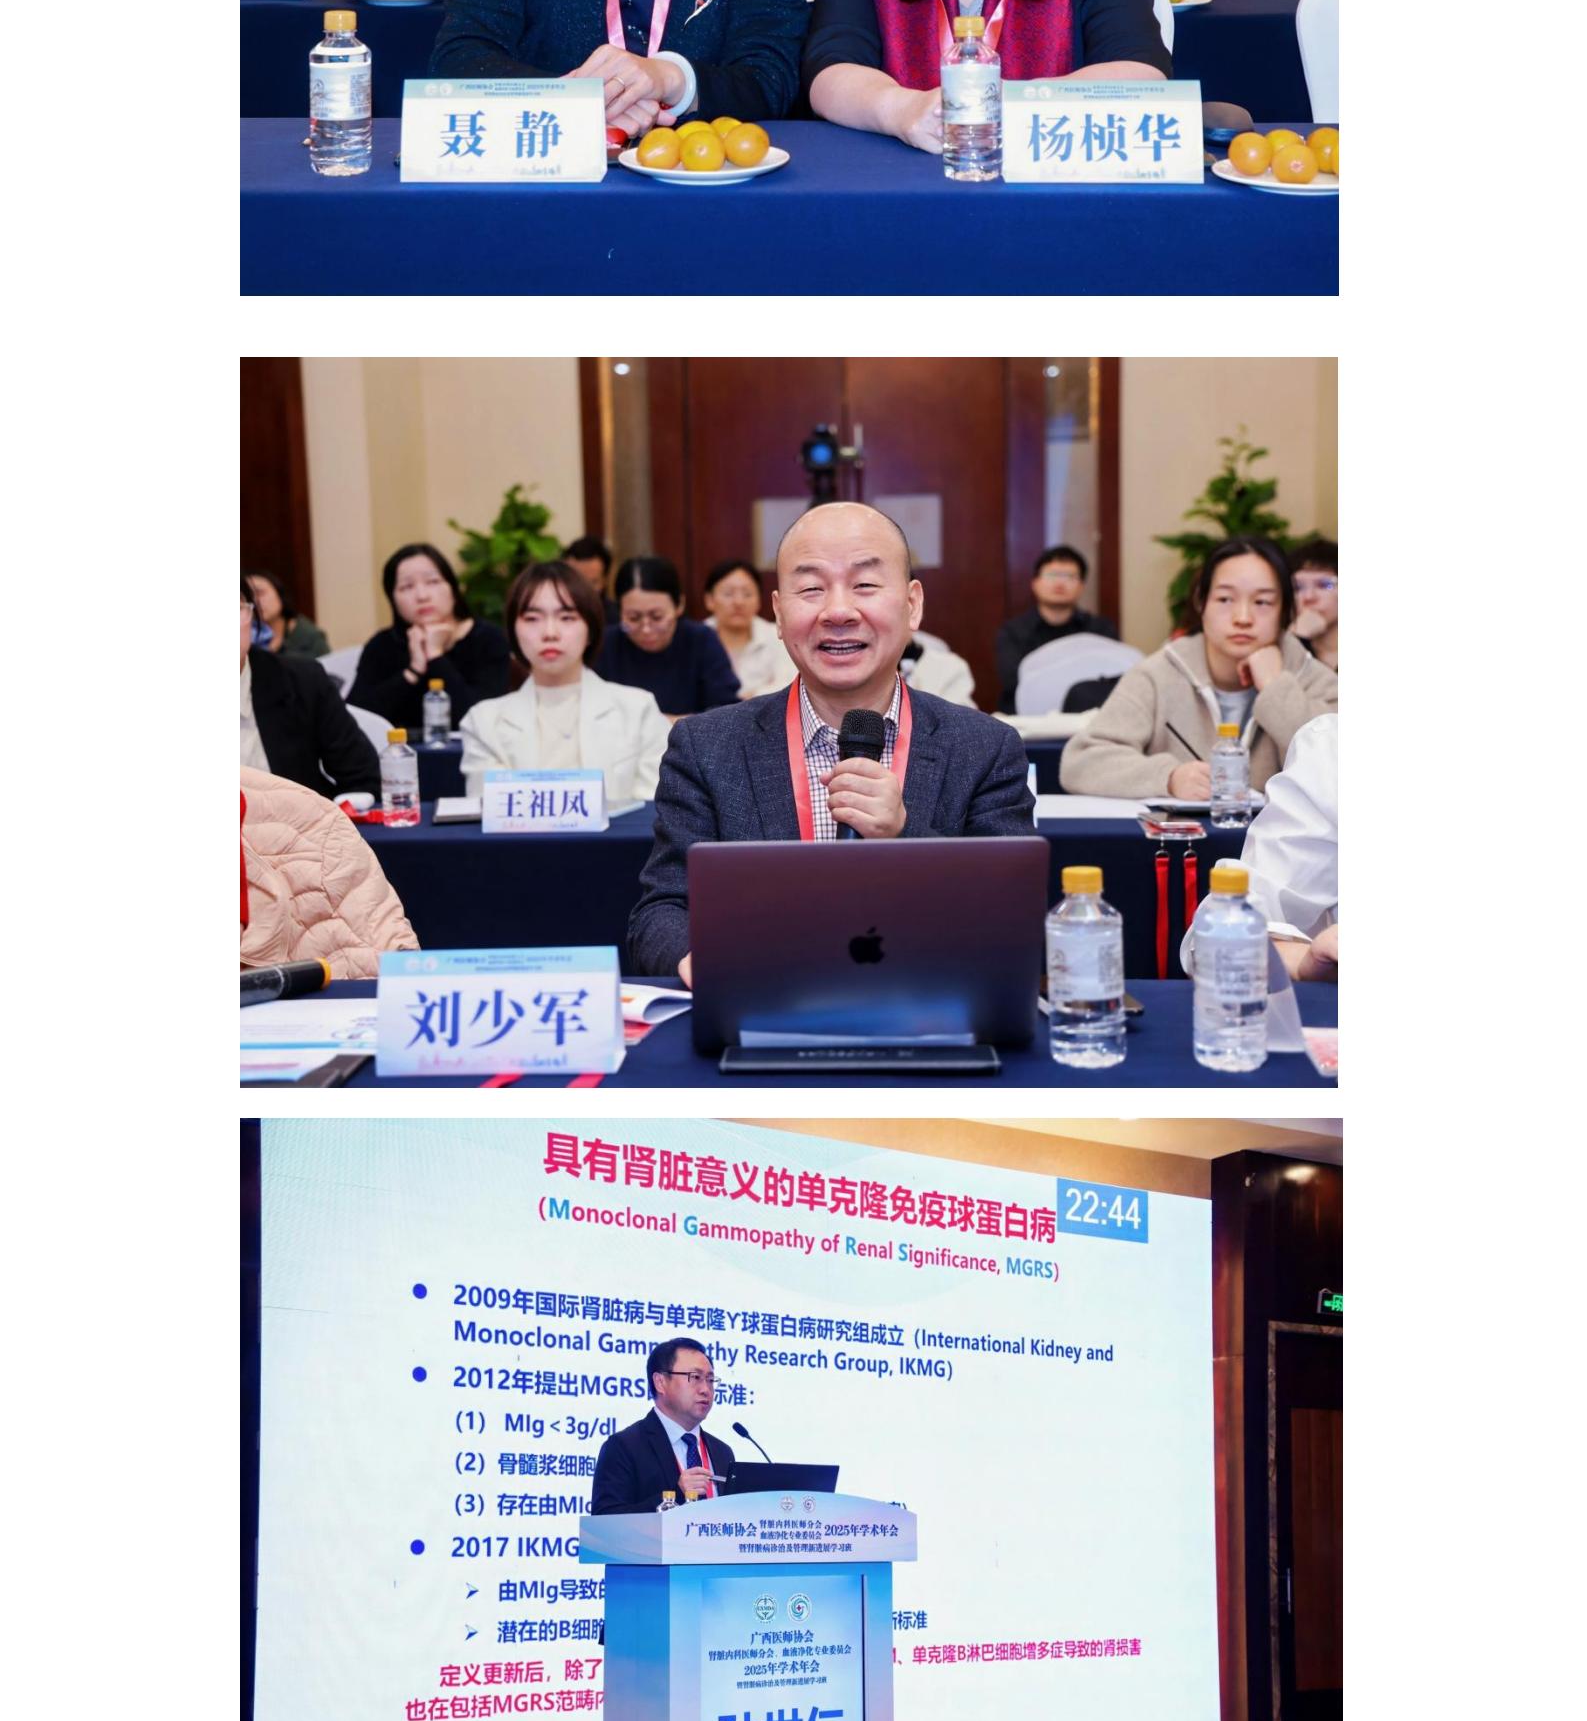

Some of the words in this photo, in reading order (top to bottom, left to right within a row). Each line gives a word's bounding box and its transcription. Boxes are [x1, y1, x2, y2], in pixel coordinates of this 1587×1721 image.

[438, 109, 564, 159] 聂静
[1026, 113, 1182, 163] 杨桢华
[405, 988, 590, 1051] 刘少军
[542, 1131, 1057, 1244] 具有肾脏意义的单克隆免疫球蛋白病
[1065, 1187, 1142, 1230] 22:44
[538, 1196, 677, 1234] (Monoclonal
[683, 1214, 815, 1255] Gammopathy
[820, 1234, 840, 1254] of
[845, 1236, 893, 1260] Renal
[898, 1243, 1001, 1275] Significance,
[1006, 1256, 1059, 1283] MGRS)
[453, 1320, 591, 1352] Monoclonal
[745, 1344, 828, 1369] Research
[834, 1352, 894, 1378] Group,
[1030, 1340, 1082, 1365] Kidney
[1086, 1344, 1114, 1363] and
[498, 1453, 597, 1477] 骨髓浆细胞
[685, 1520, 758, 1538] 广西医师协会
[824, 1523, 899, 1538] 2025年学术年会
[451, 1536, 510, 1558] 2017
[517, 1536, 580, 1558] IKMG
[892, 1610, 928, 1631] 标准
[750, 1629, 814, 1646] 广西医师协会
[892, 1638, 1142, 1666] 、单克隆B淋巴细胞增多症导致的肾损害
[744, 1659, 820, 1676] 2025年学术年会
